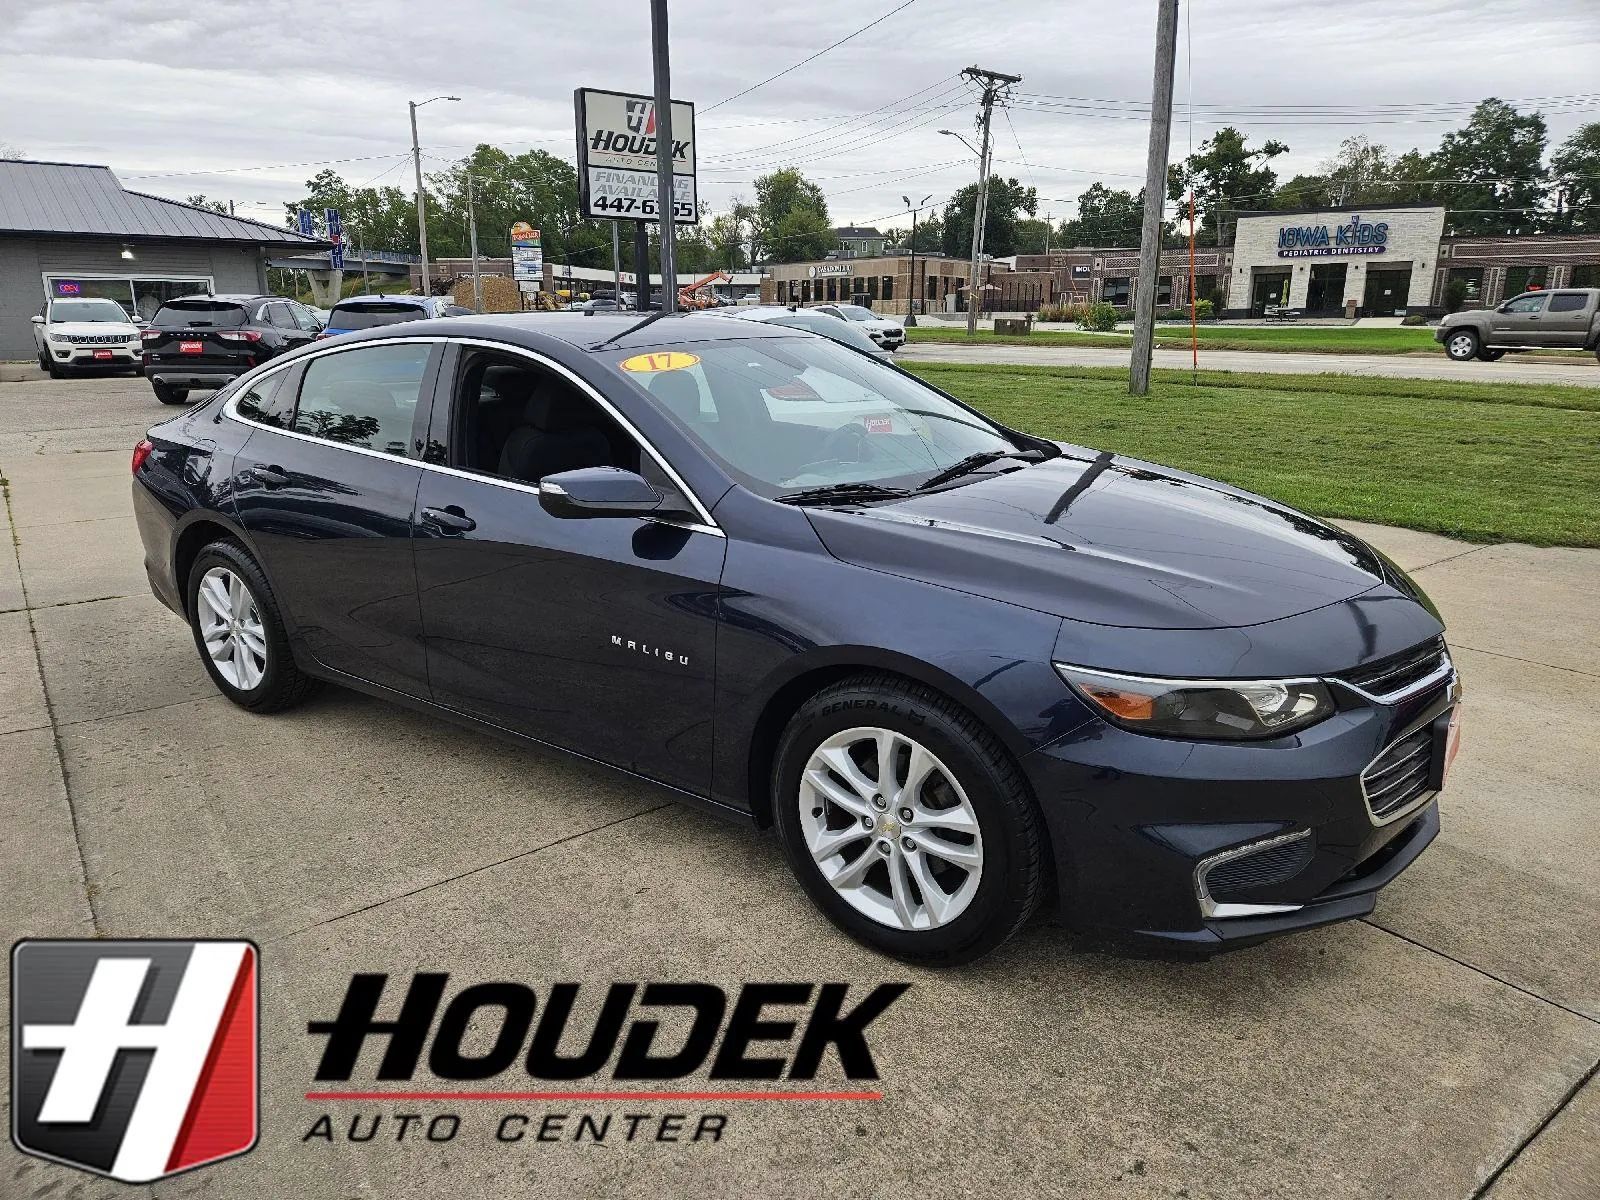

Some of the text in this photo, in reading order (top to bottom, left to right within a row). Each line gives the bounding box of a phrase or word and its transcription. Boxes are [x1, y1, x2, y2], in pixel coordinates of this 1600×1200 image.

[590, 129, 690, 159] HOUDK
[1278, 226, 1329, 248] IOWA
[1283, 246, 1380, 257] PEDIATRIC DENTISTRY
[643, 353, 672, 371] 17
[611, 635, 689, 666] MALIBU
[822, 699, 899, 717] GENERAL
